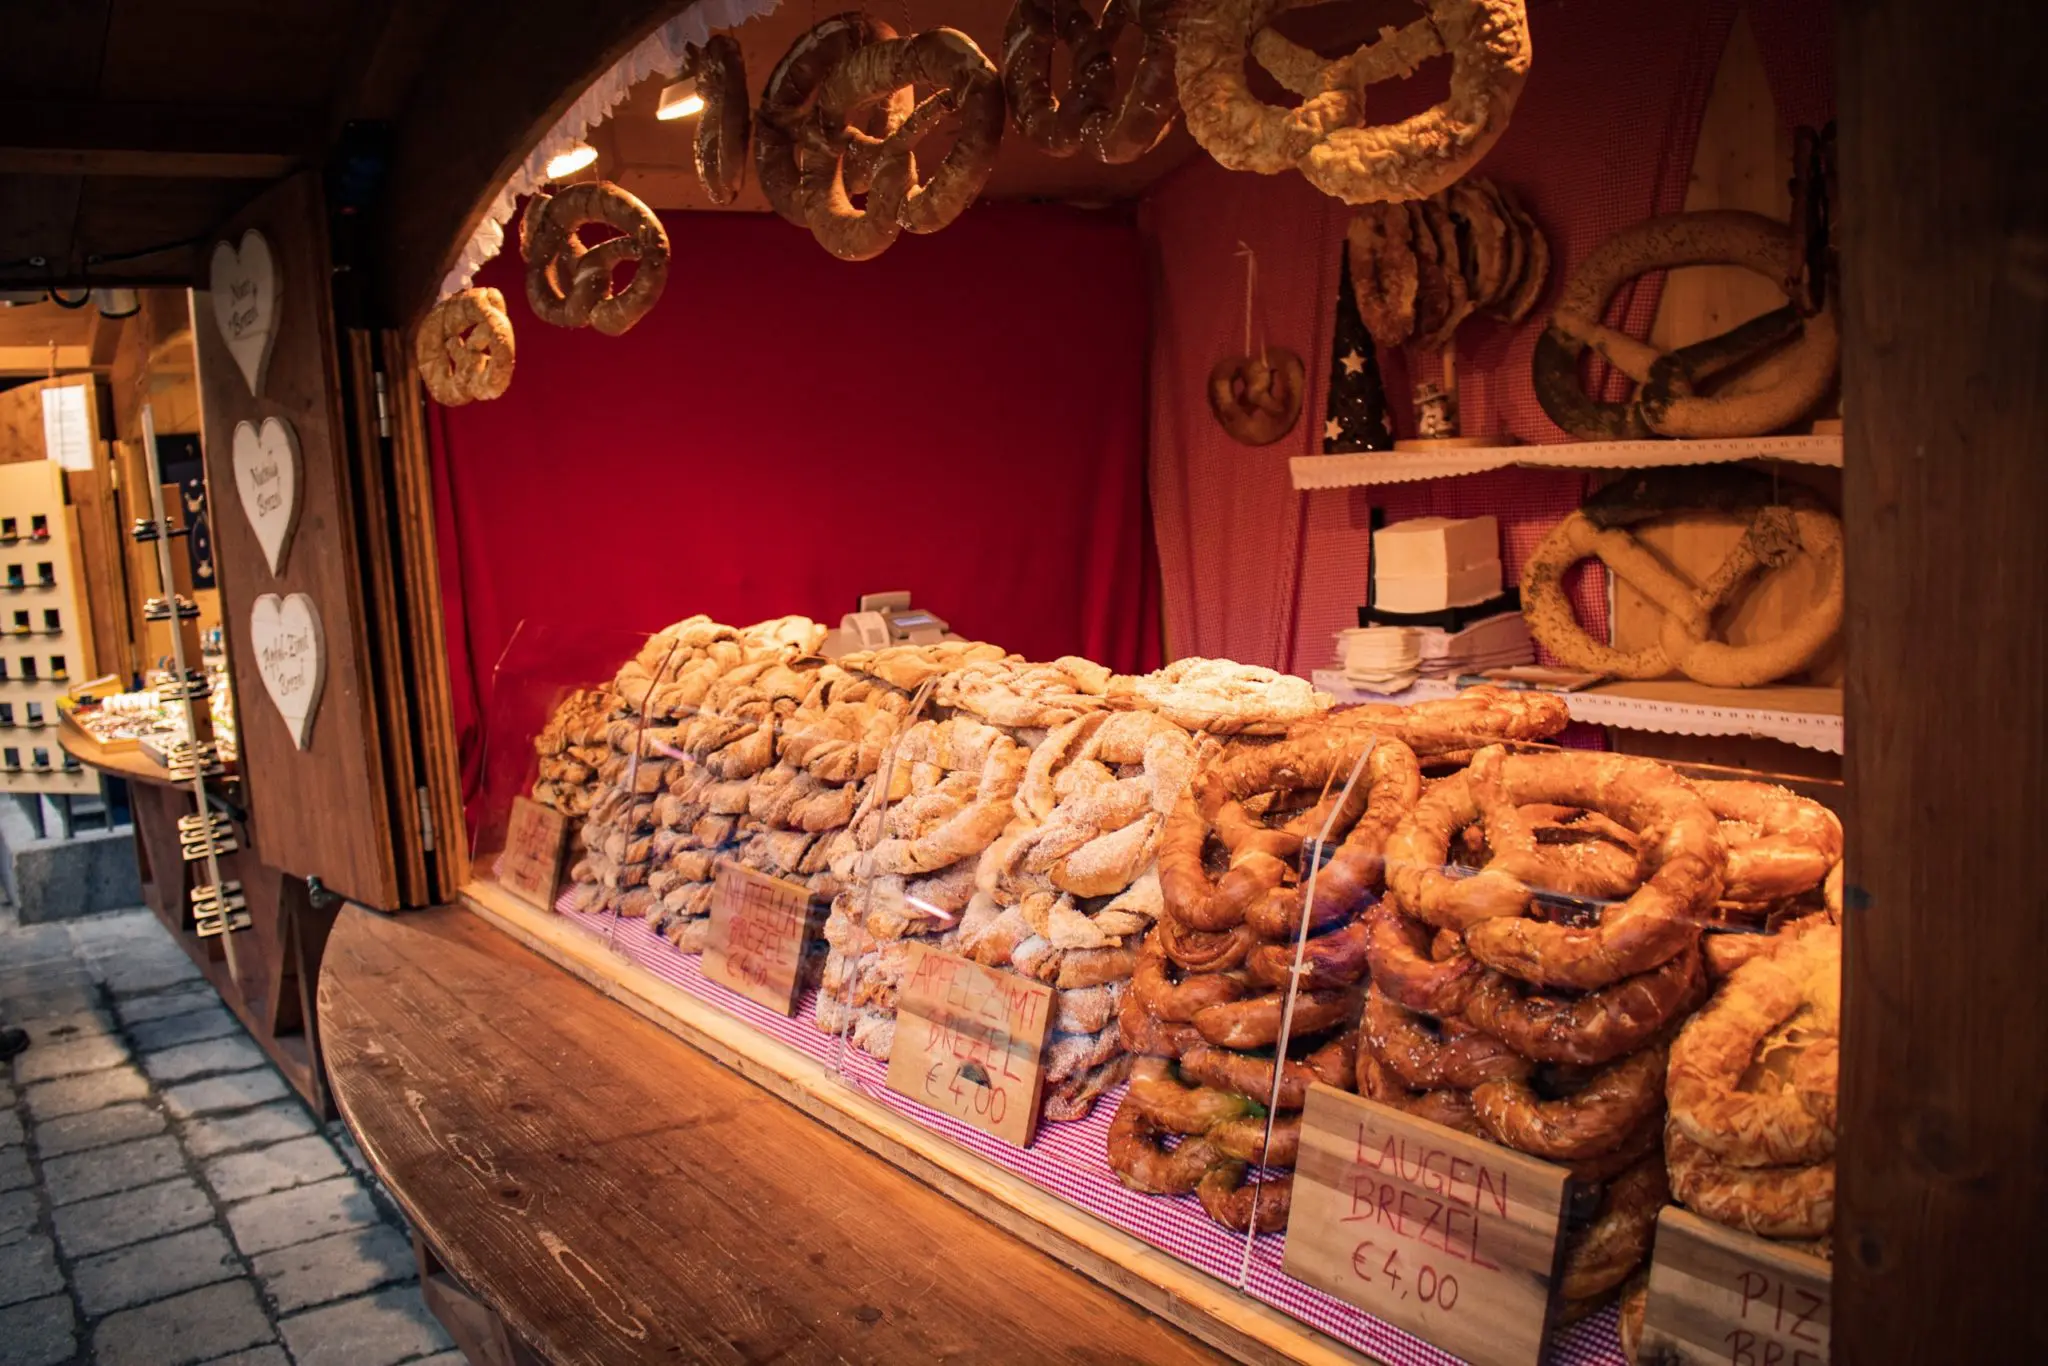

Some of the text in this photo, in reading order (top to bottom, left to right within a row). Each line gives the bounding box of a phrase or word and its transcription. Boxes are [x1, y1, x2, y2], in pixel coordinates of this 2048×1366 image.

[1355, 1122, 1507, 1220] LAUGEN
[1340, 1174, 1500, 1272] BREZEL
[1351, 1241, 1459, 1311] €4,00
